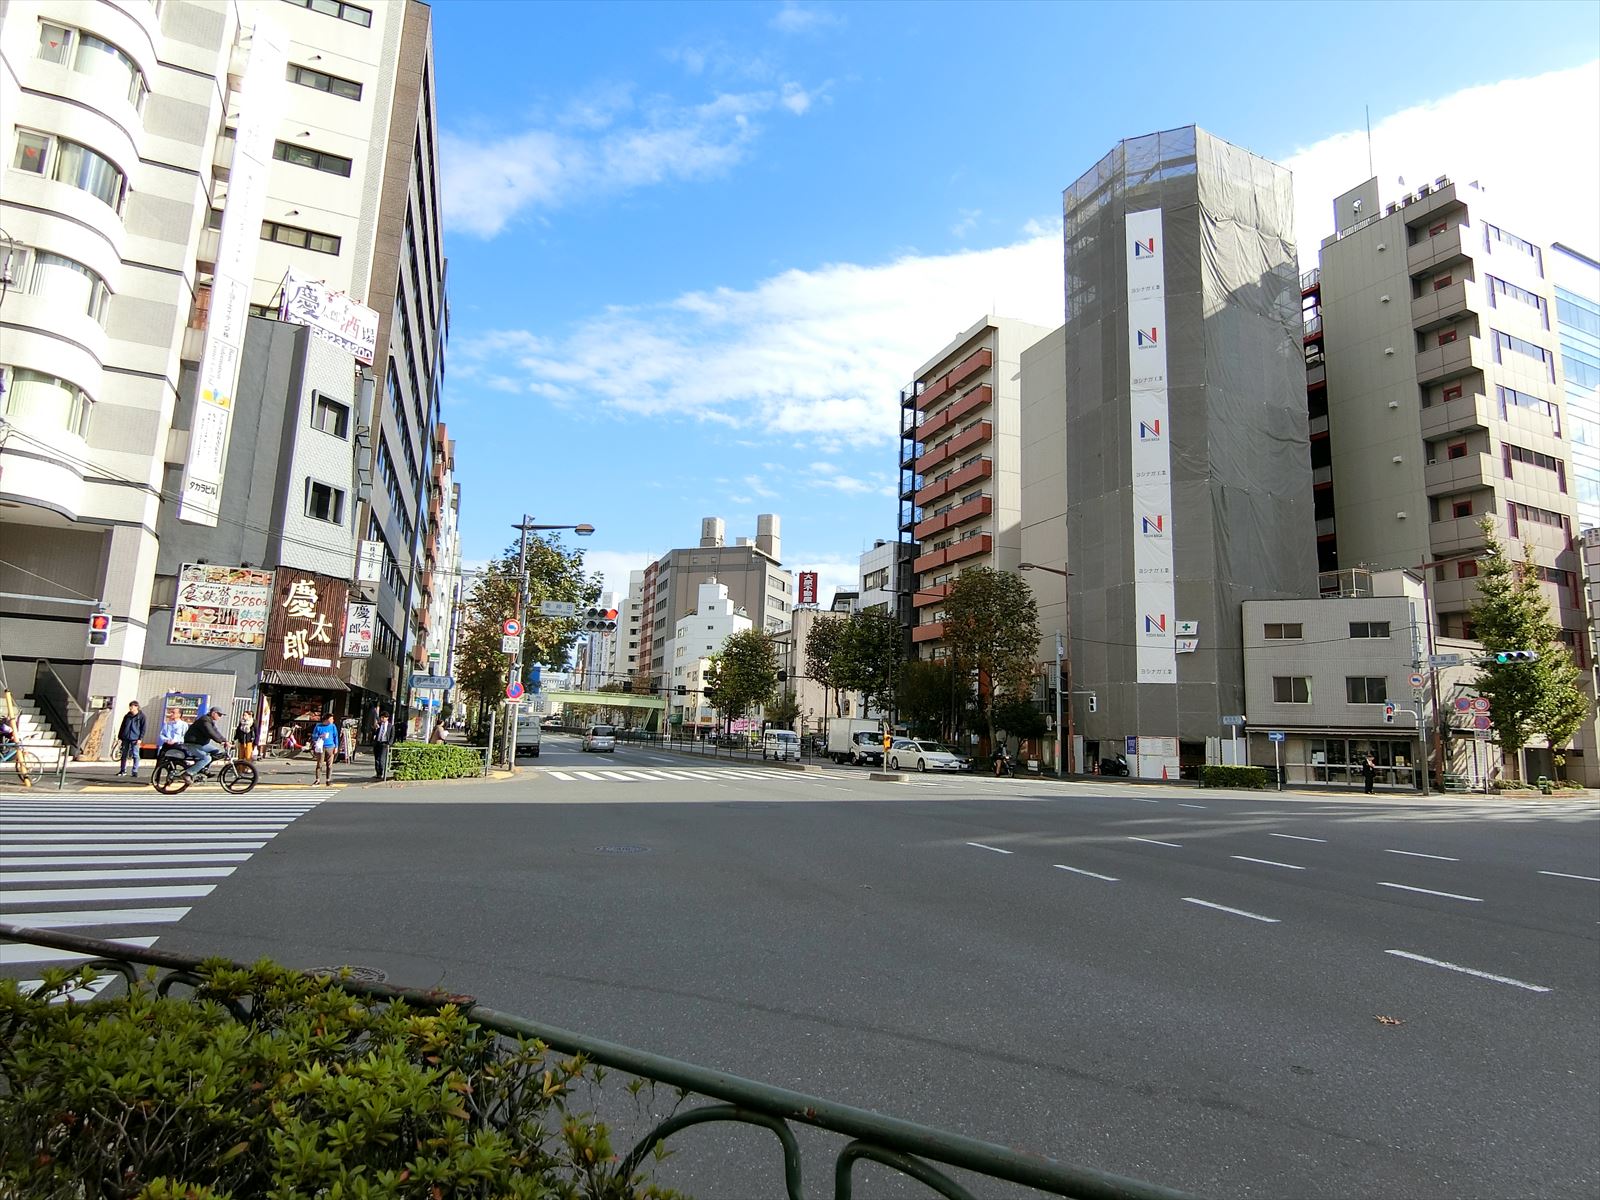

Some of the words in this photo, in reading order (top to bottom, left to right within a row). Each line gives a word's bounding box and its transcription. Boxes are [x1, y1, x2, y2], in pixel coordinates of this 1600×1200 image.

[190, 481, 216, 496] タカラビル
[282, 579, 332, 660] 慶太郎
[349, 604, 370, 634] 慶太郎
